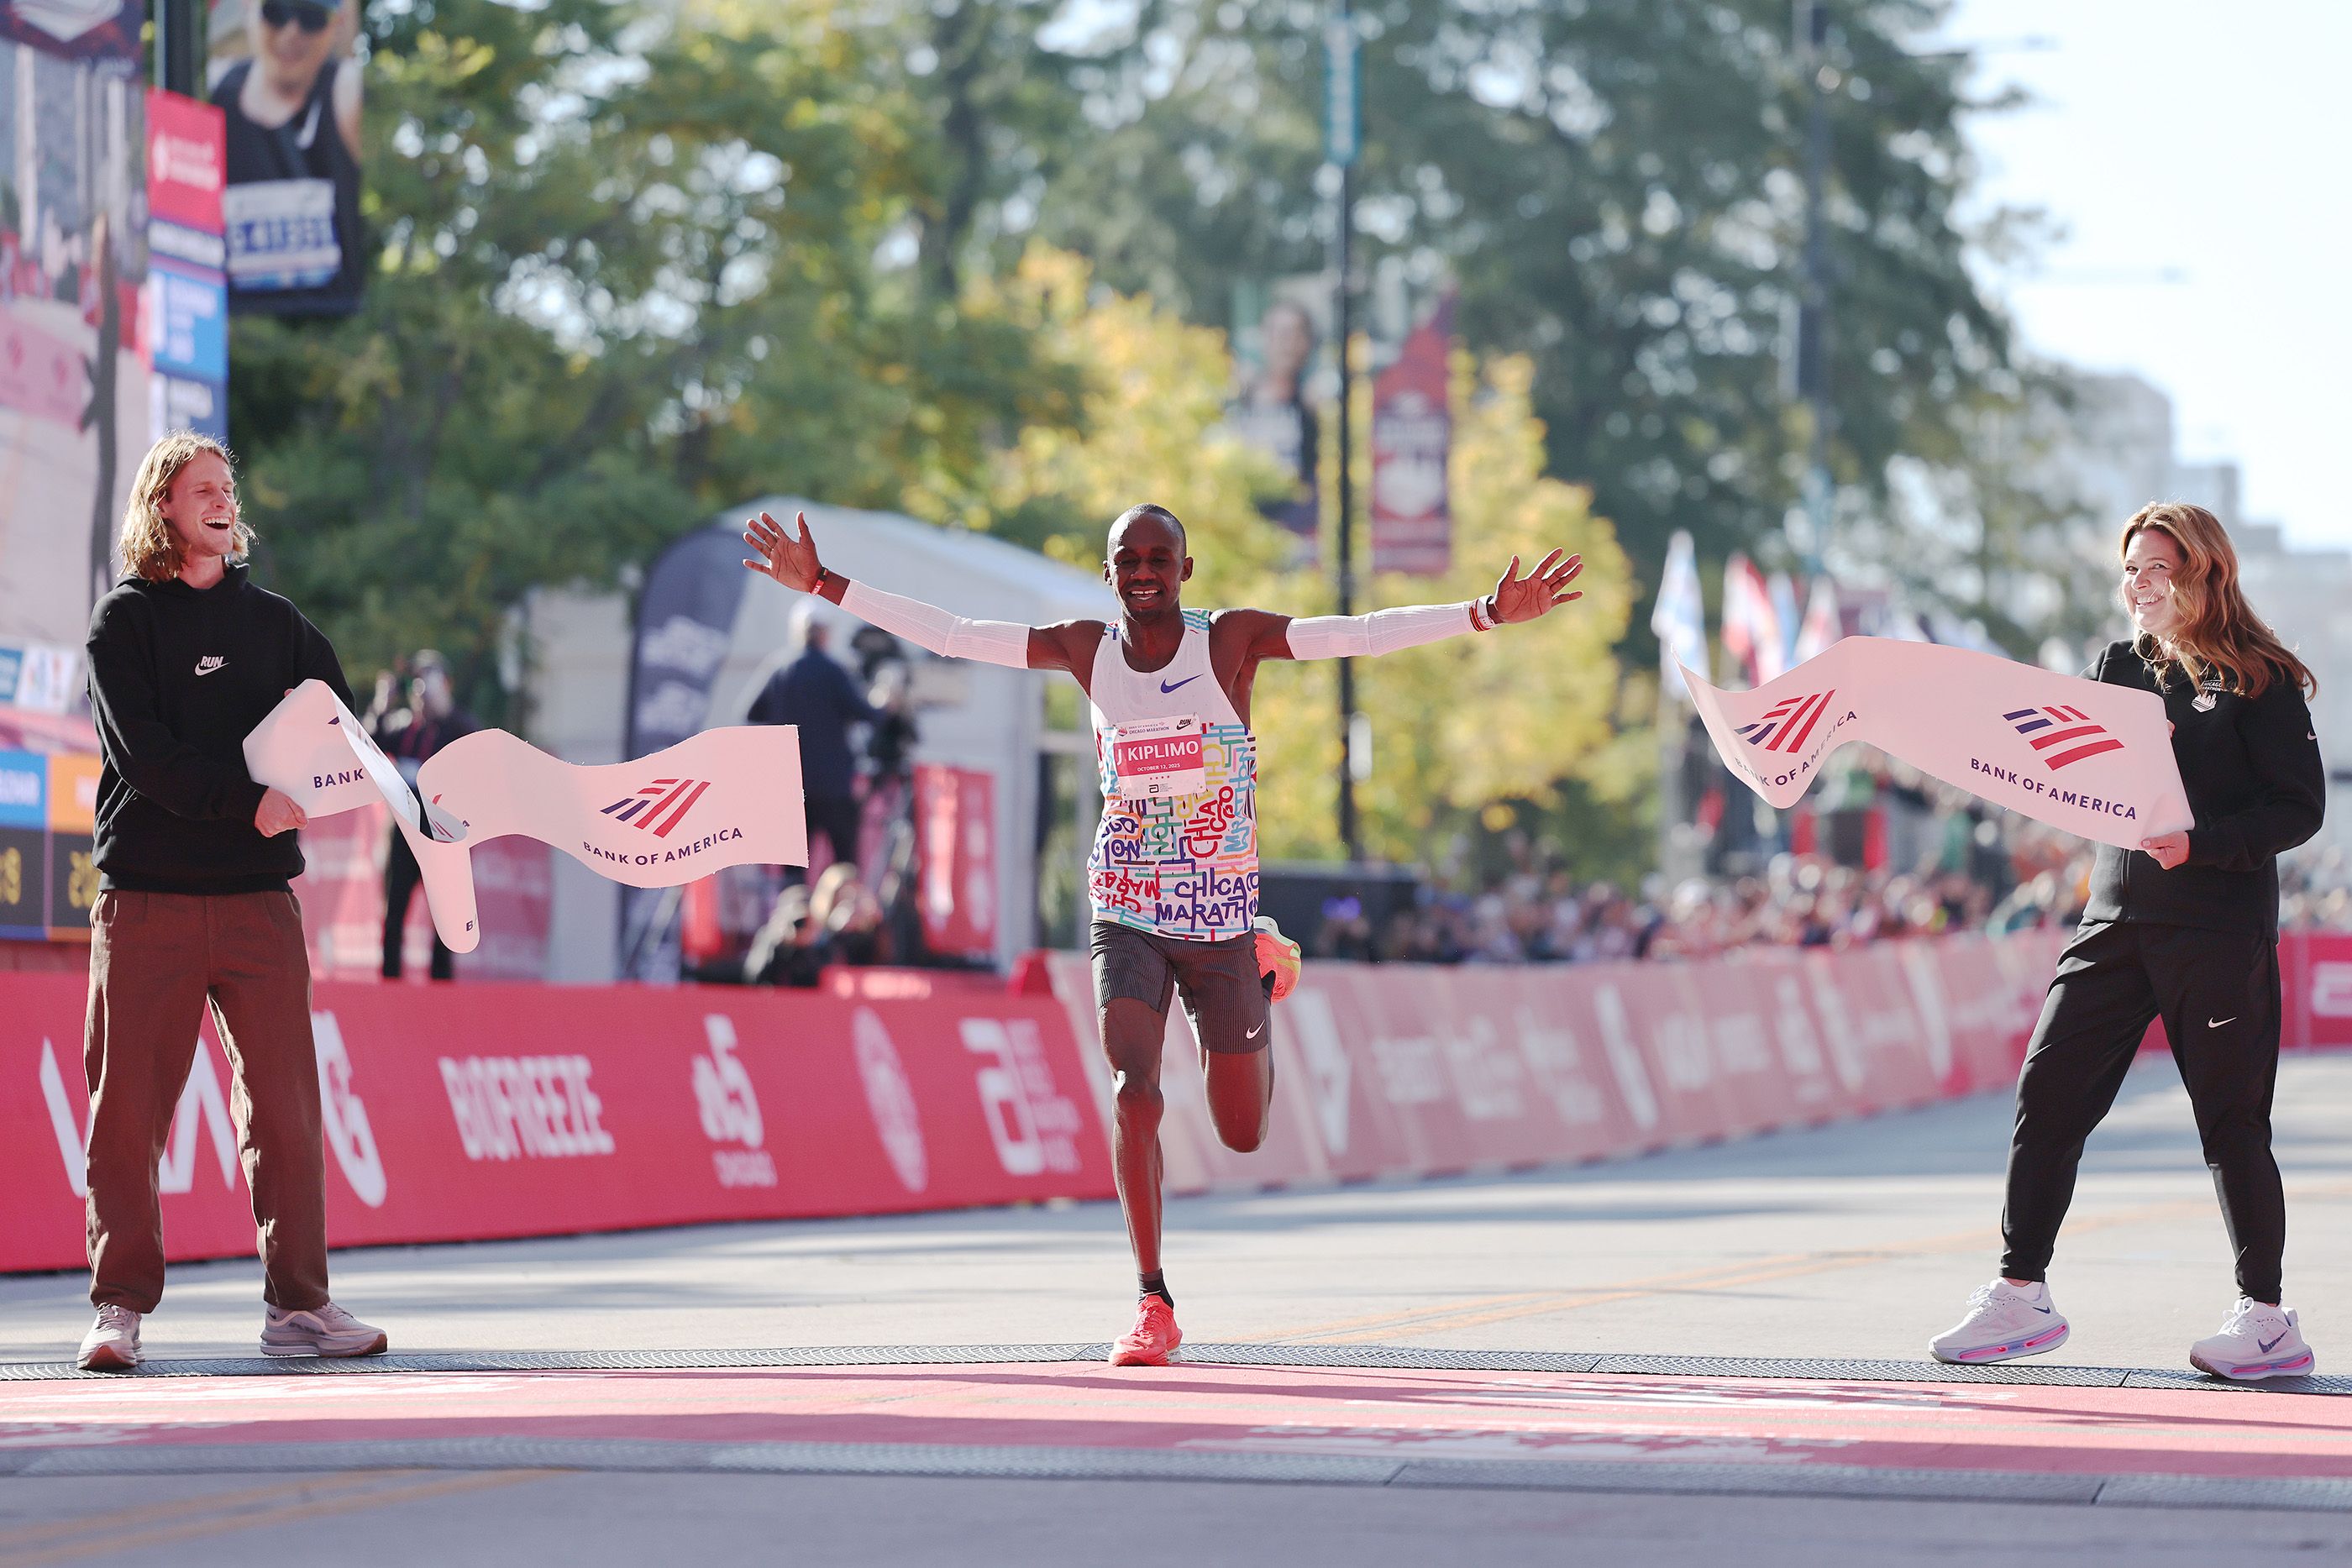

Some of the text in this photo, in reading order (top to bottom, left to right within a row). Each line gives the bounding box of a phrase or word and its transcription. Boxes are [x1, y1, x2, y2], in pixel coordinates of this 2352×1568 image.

[200, 655, 224, 668] RUN
[1116, 740, 1200, 766] J KIPLIMO
[1775, 768, 1797, 786] OF
[1801, 711, 1857, 773] AMERICA
[313, 768, 365, 789] BANK
[1971, 758, 2137, 820] BANK OF AMERICA
[583, 827, 743, 866] BANK OF AMERICA
[438, 1055, 617, 1162] BIOFREEZE
